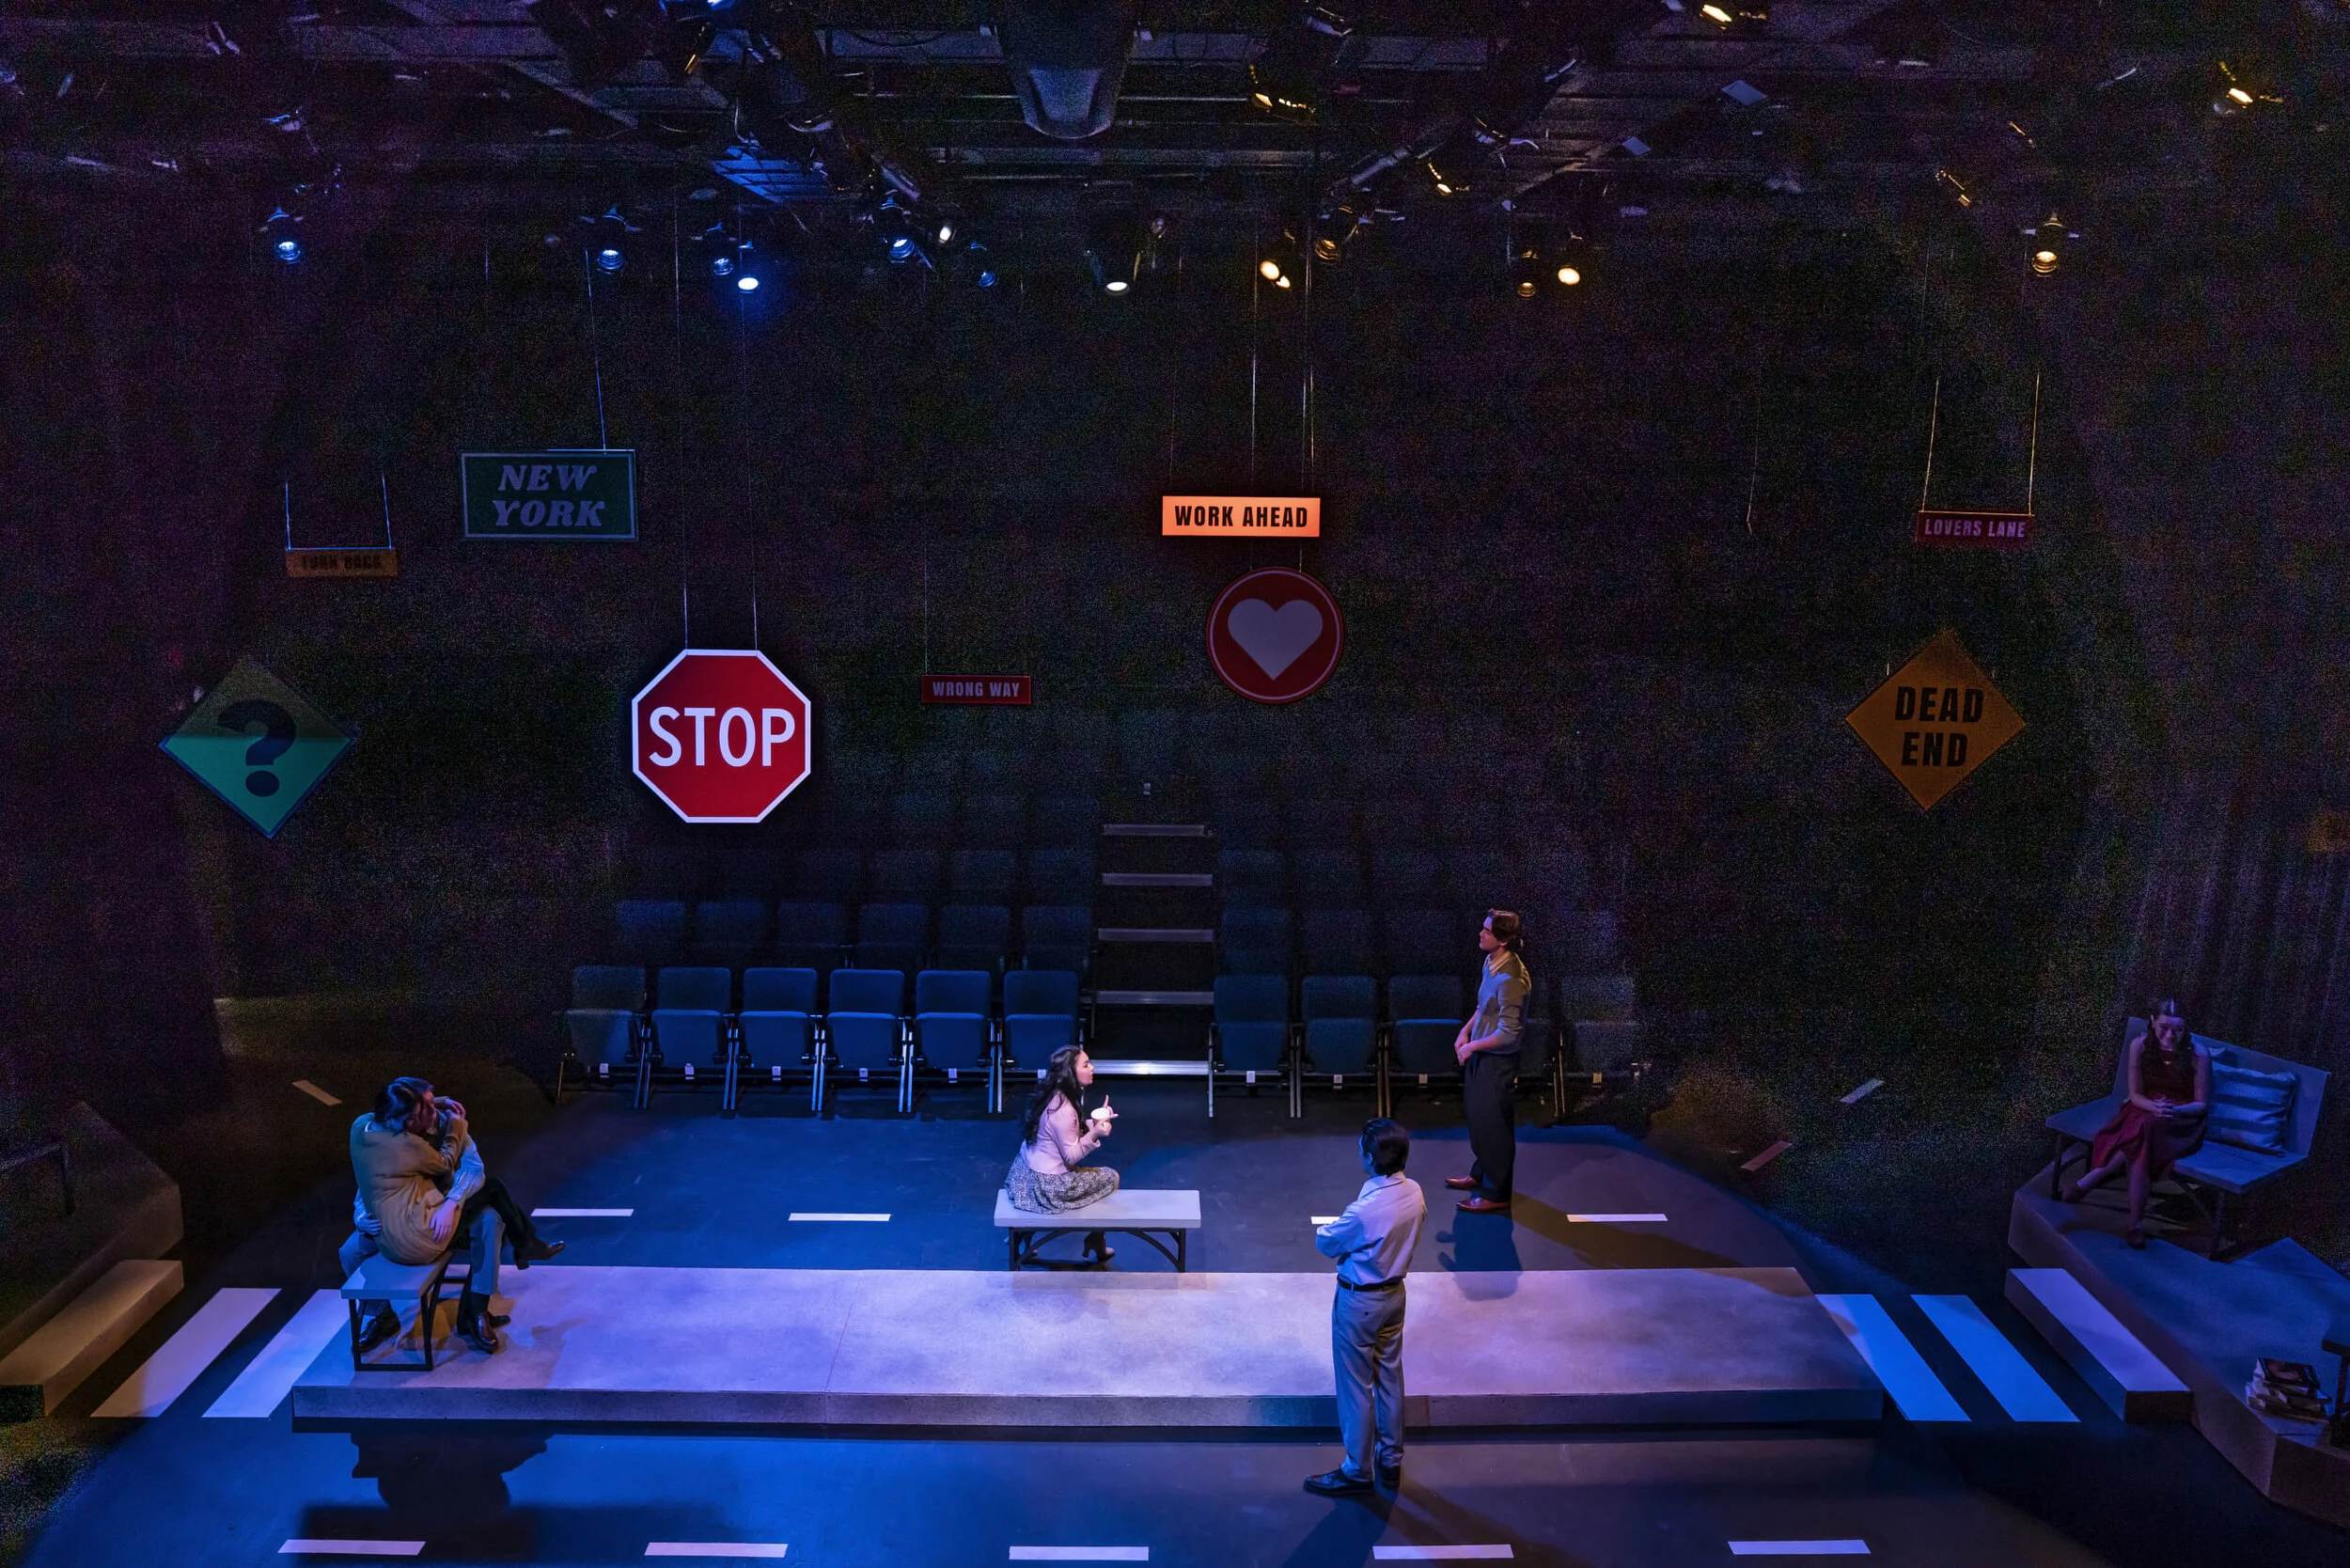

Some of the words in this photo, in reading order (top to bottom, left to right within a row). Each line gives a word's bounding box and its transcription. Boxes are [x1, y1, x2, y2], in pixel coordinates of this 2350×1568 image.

[497, 464, 597, 491] NEW
[493, 500, 605, 526] YORK
[1175, 506, 1233, 526] WORK
[1243, 507, 1308, 527] AHEAD
[1924, 518, 1982, 537] LOVERS
[1987, 520, 2027, 538] LANE
[932, 681, 984, 697] WRONG
[989, 682, 1020, 698] WAY
[1895, 686, 1984, 723] DEAD
[218, 698, 296, 797] ?
[649, 706, 795, 767] STOP
[1902, 731, 1967, 766] END
